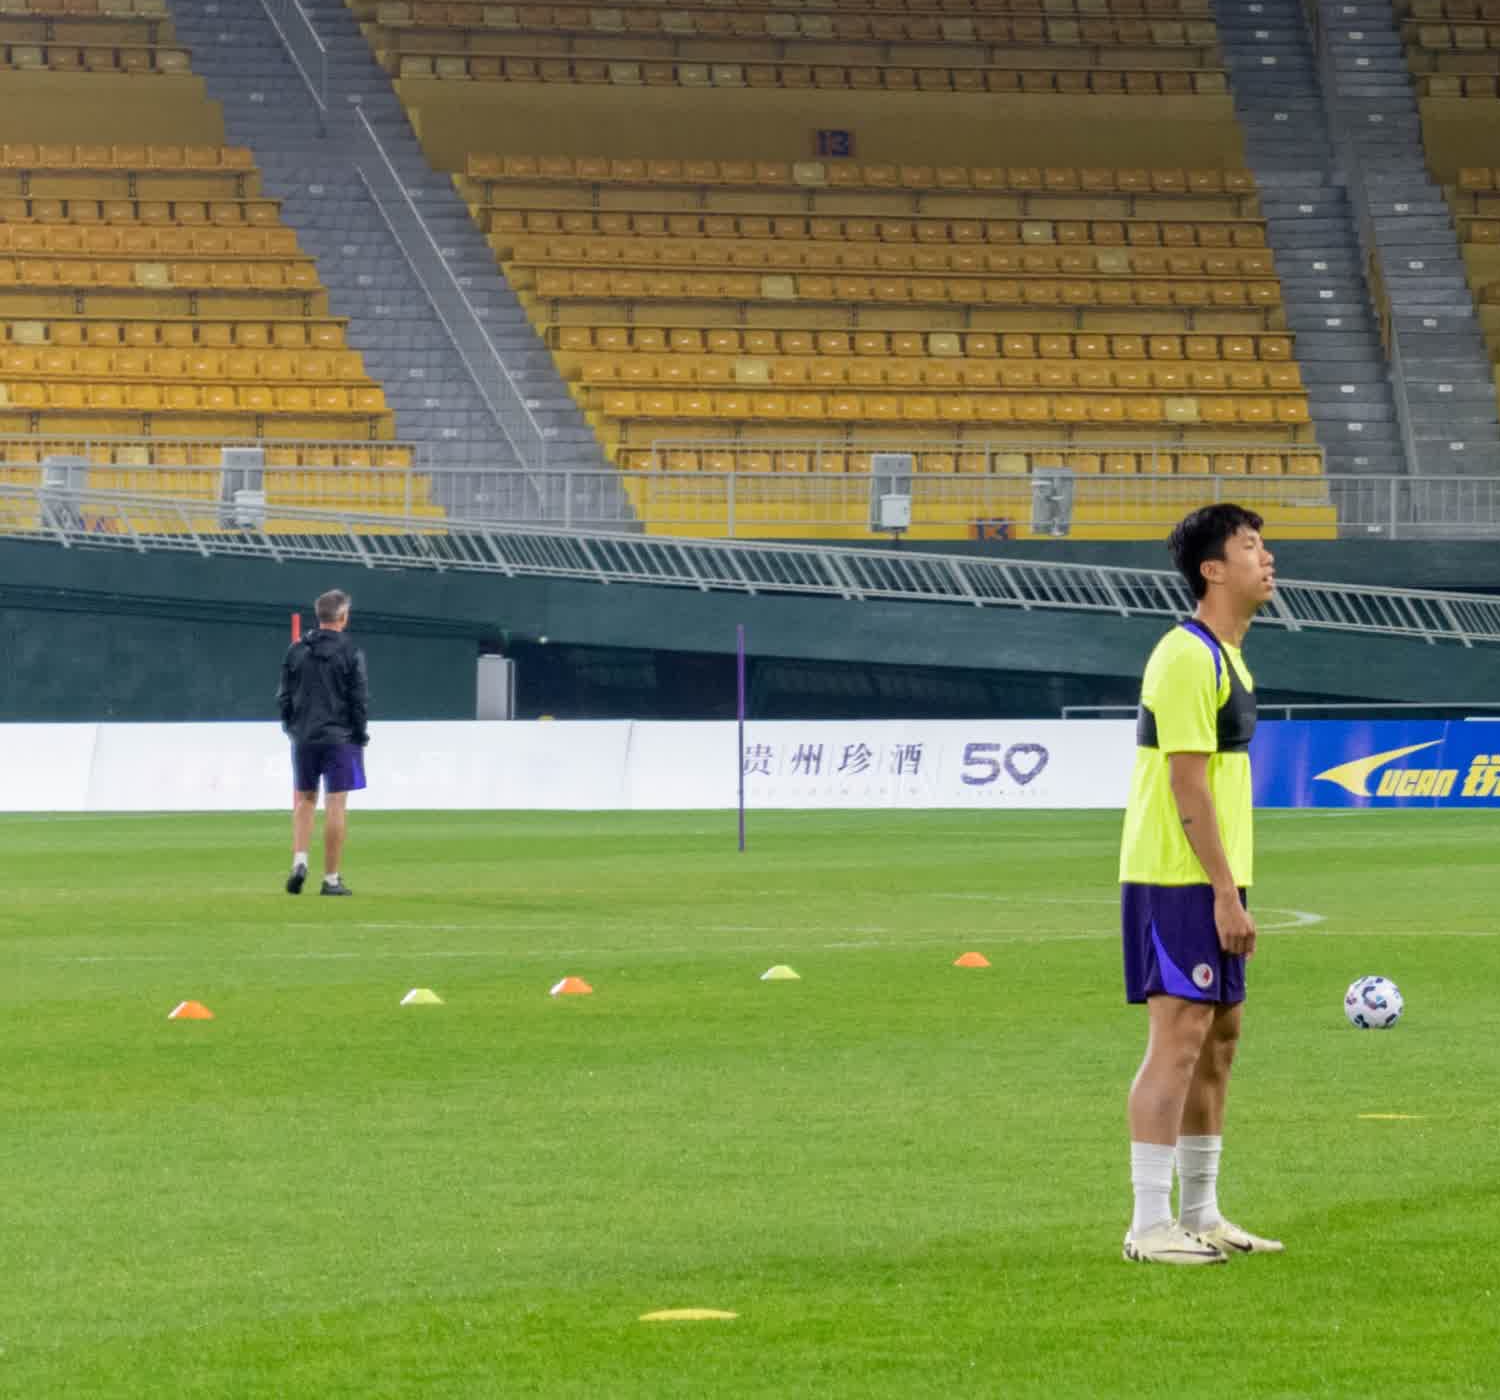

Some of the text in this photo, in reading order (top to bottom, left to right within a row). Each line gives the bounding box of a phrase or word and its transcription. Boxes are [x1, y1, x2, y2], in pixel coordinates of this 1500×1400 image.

[816, 130, 849, 157] 13
[741, 742, 925, 776] 贵州珍酒
